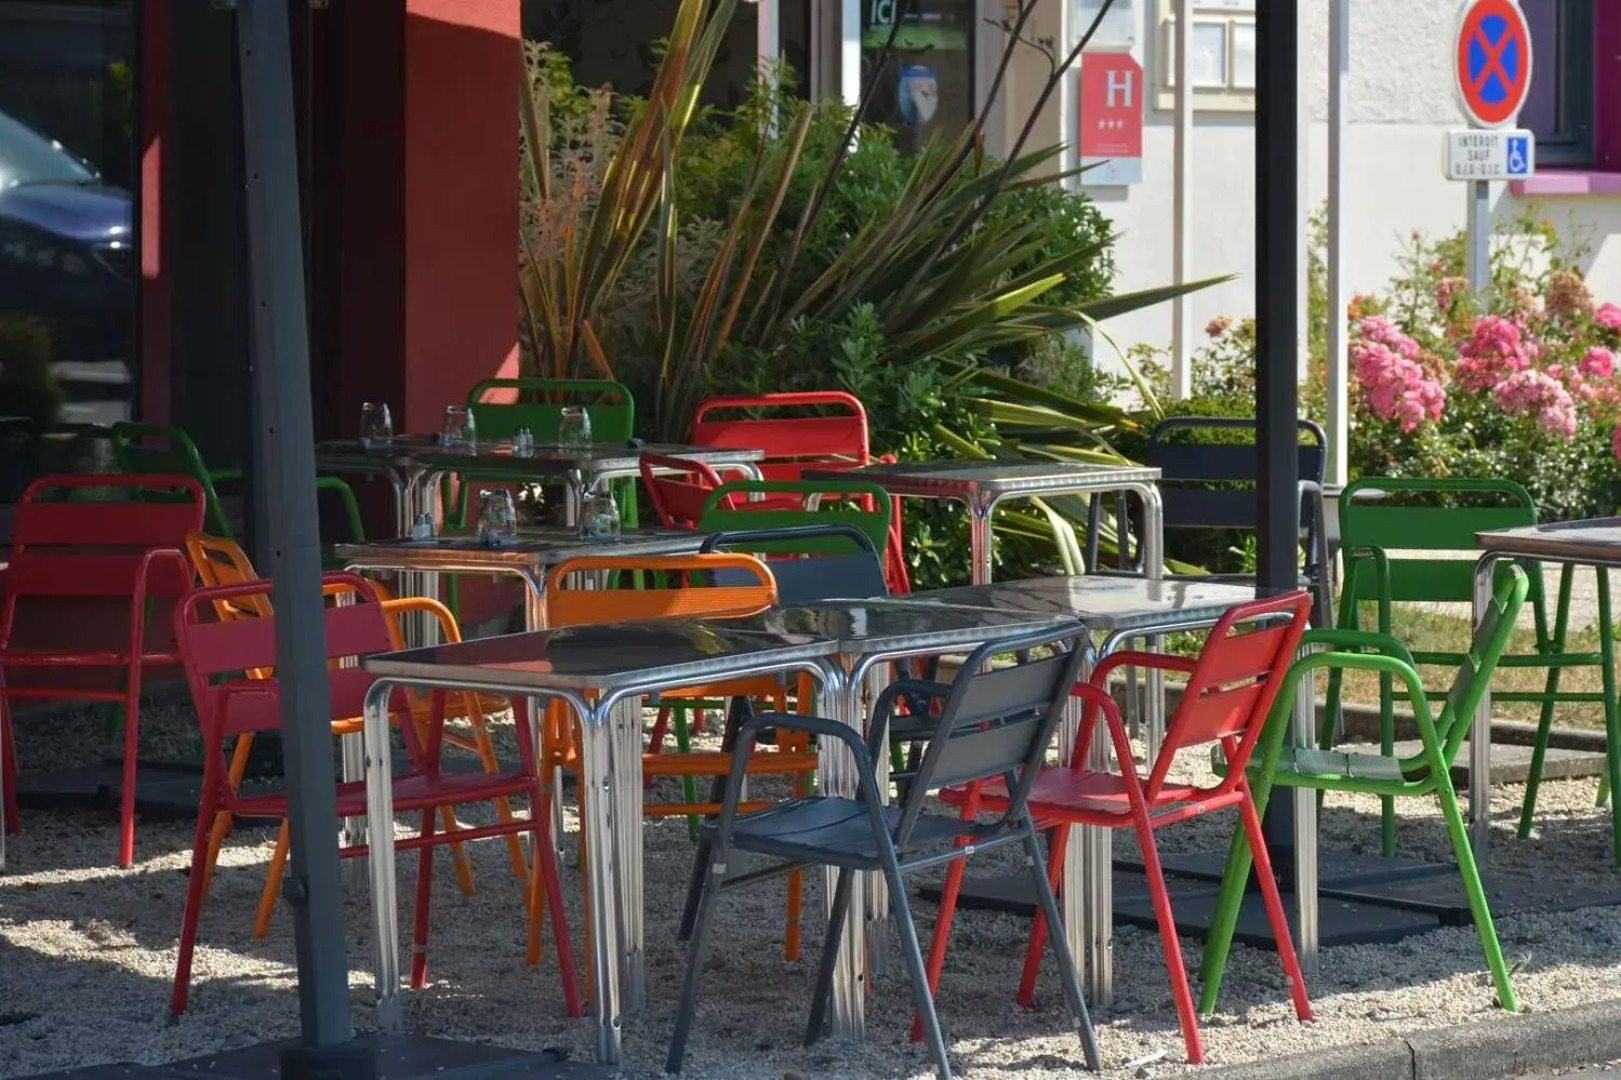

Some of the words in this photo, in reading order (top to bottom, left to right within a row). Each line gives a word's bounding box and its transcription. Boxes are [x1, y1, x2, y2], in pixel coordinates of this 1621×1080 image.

[1105, 70, 1133, 108] H
[1458, 135, 1498, 147] INTERDIT
[1468, 149, 1490, 161] SAUF
